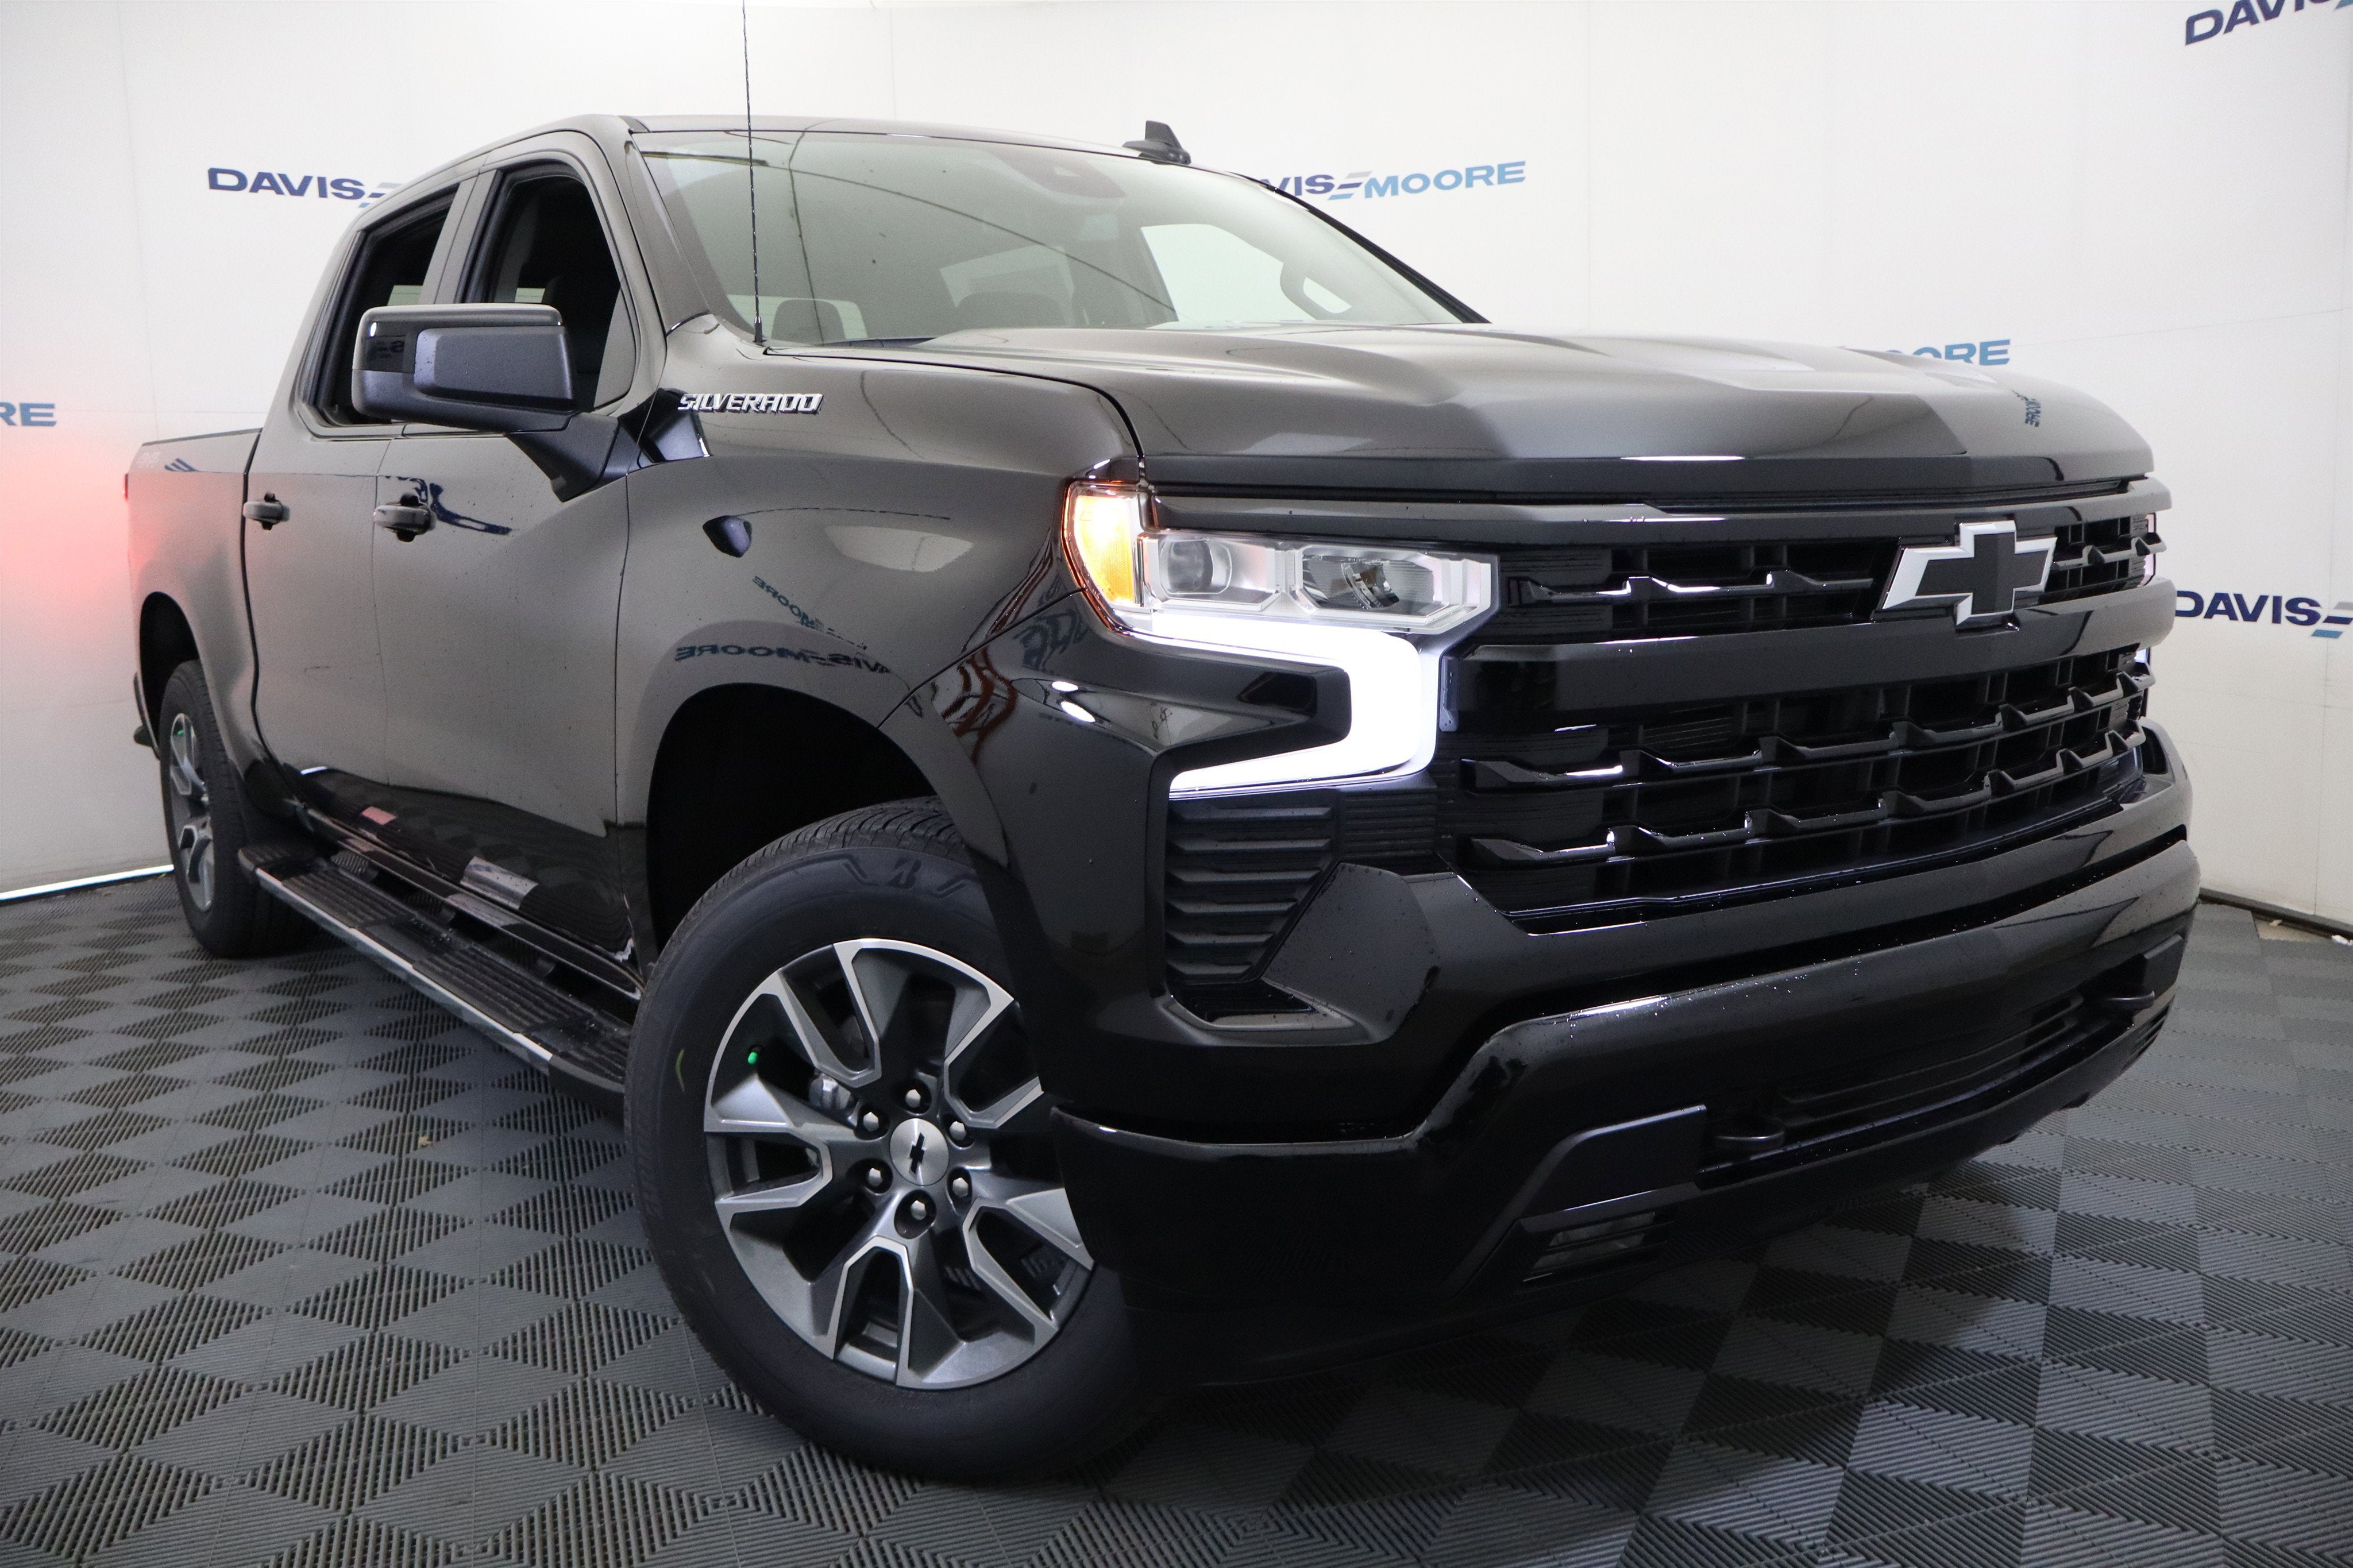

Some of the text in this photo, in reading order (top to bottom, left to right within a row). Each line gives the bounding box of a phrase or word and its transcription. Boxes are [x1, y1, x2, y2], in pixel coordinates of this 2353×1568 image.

[2185, 0, 2328, 45] DAV
[208, 168, 365, 200] DAVIS
[1364, 160, 1526, 198] MOORE
[678, 393, 824, 414] SILVERADO
[2175, 590, 2321, 626] DAVIS
